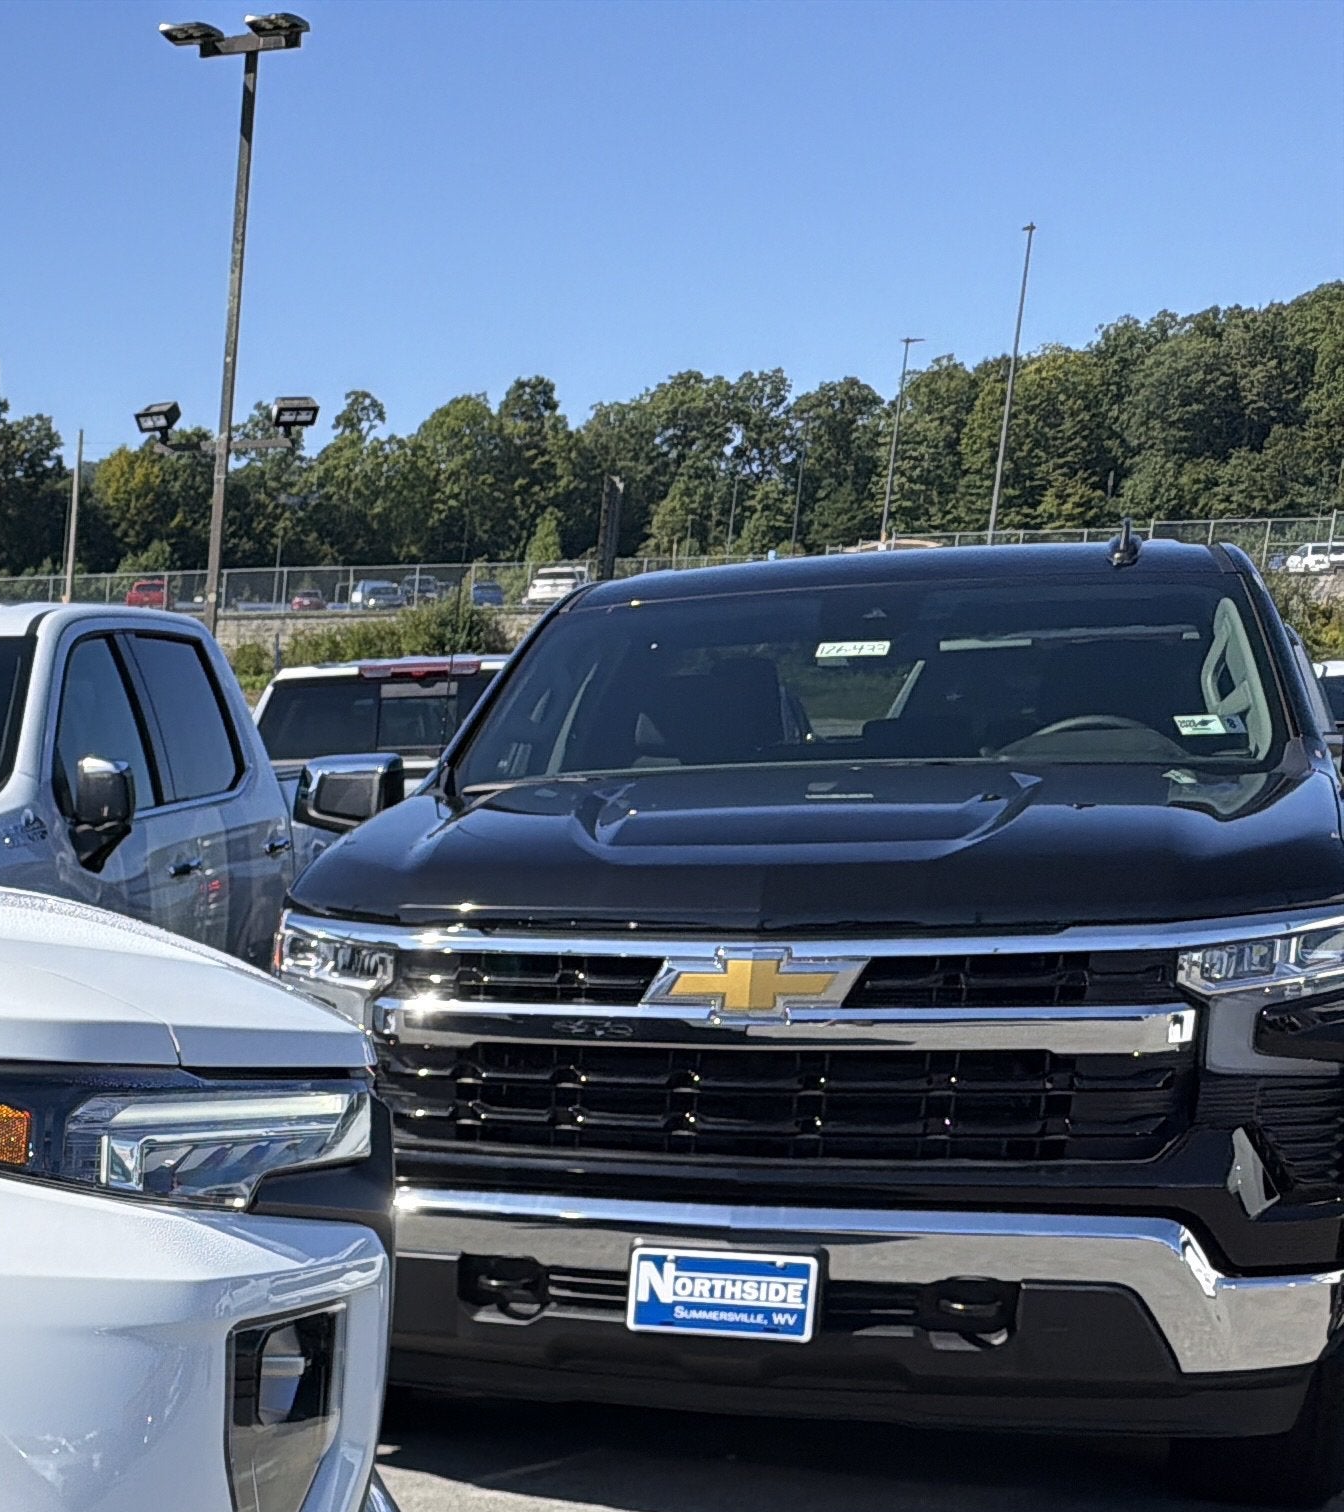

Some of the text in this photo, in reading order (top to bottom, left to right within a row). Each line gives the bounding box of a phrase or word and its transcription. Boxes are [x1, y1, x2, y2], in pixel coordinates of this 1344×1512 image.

[637, 1260, 804, 1304] NORTHSIDE
[673, 1305, 798, 1326] SUMMERSVILLE, WV
